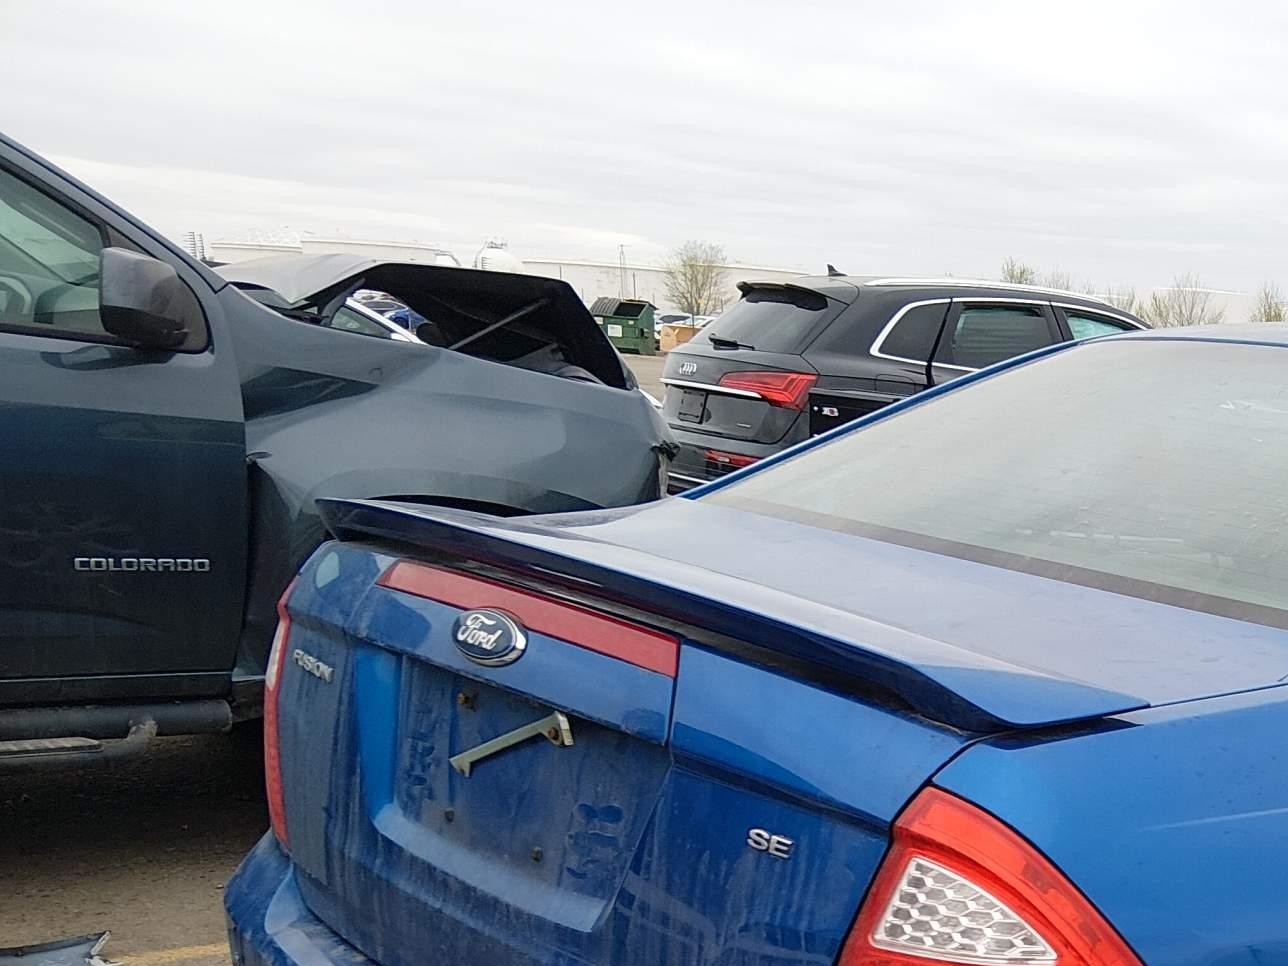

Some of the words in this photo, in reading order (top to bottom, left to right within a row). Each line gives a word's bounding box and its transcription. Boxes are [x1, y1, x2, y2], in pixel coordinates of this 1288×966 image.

[74, 557, 210, 572] COLORADO
[457, 613, 503, 650] Ford
[293, 649, 334, 682] FUSION
[747, 828, 793, 858] SE
